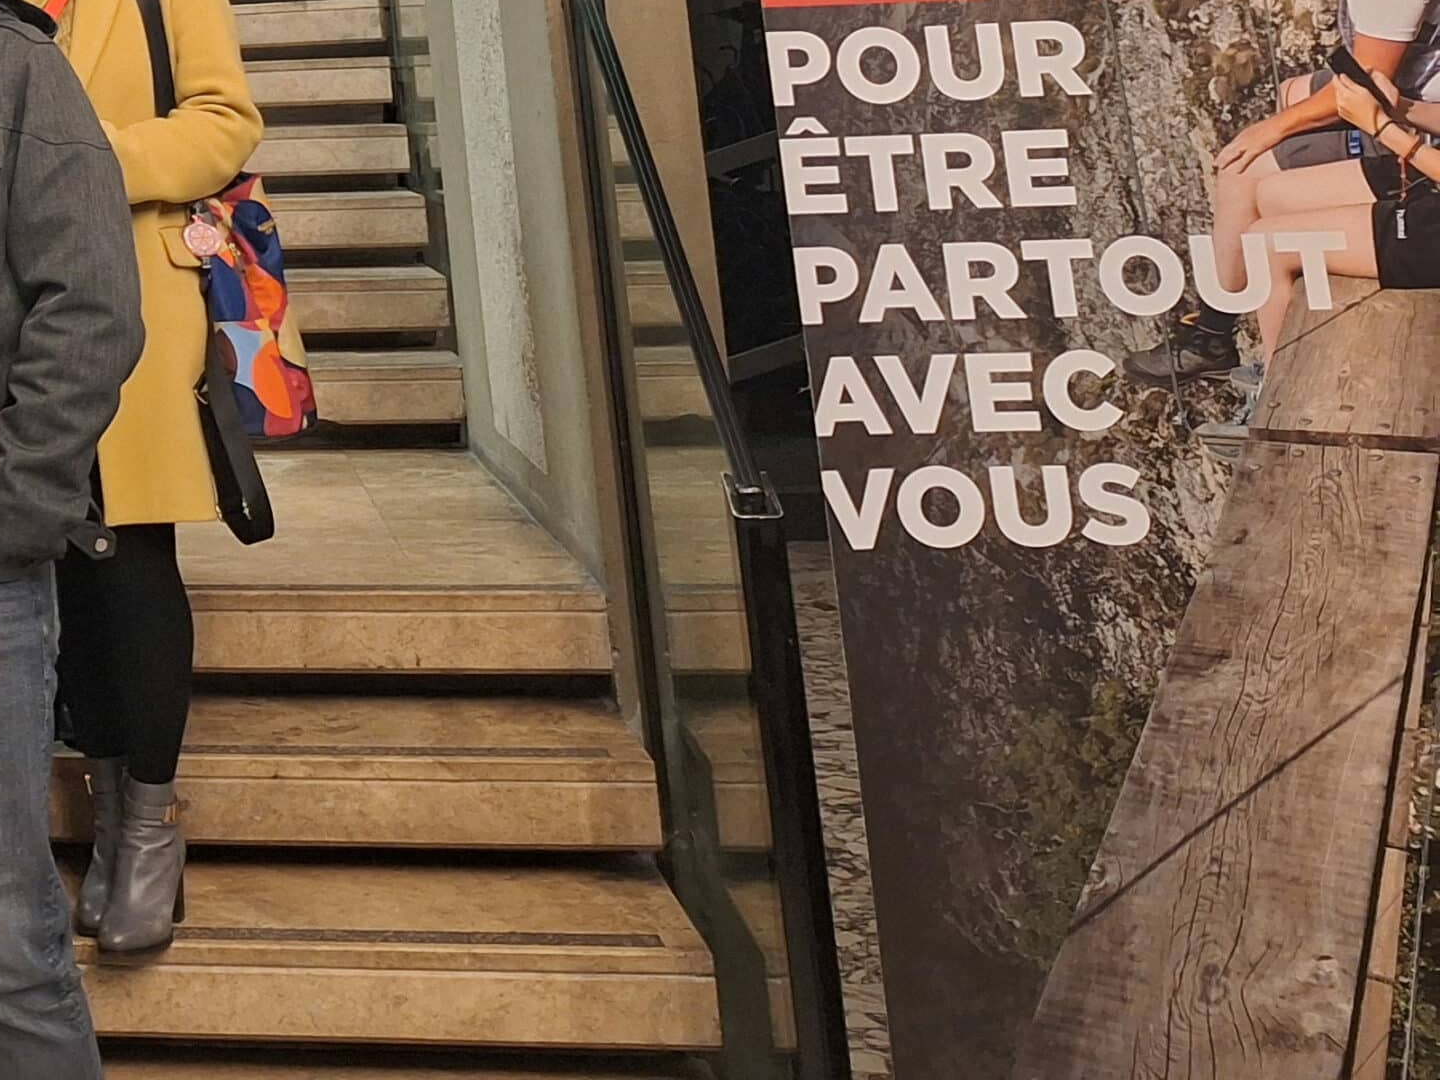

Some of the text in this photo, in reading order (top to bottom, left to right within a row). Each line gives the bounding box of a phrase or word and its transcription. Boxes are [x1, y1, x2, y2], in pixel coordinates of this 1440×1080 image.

[765, 21, 1093, 107] POUR
[778, 117, 1077, 215] ÊTRE
[792, 231, 1346, 325] PARTOUT
[814, 349, 1124, 437] AVEC
[822, 463, 1151, 550] VOUS
